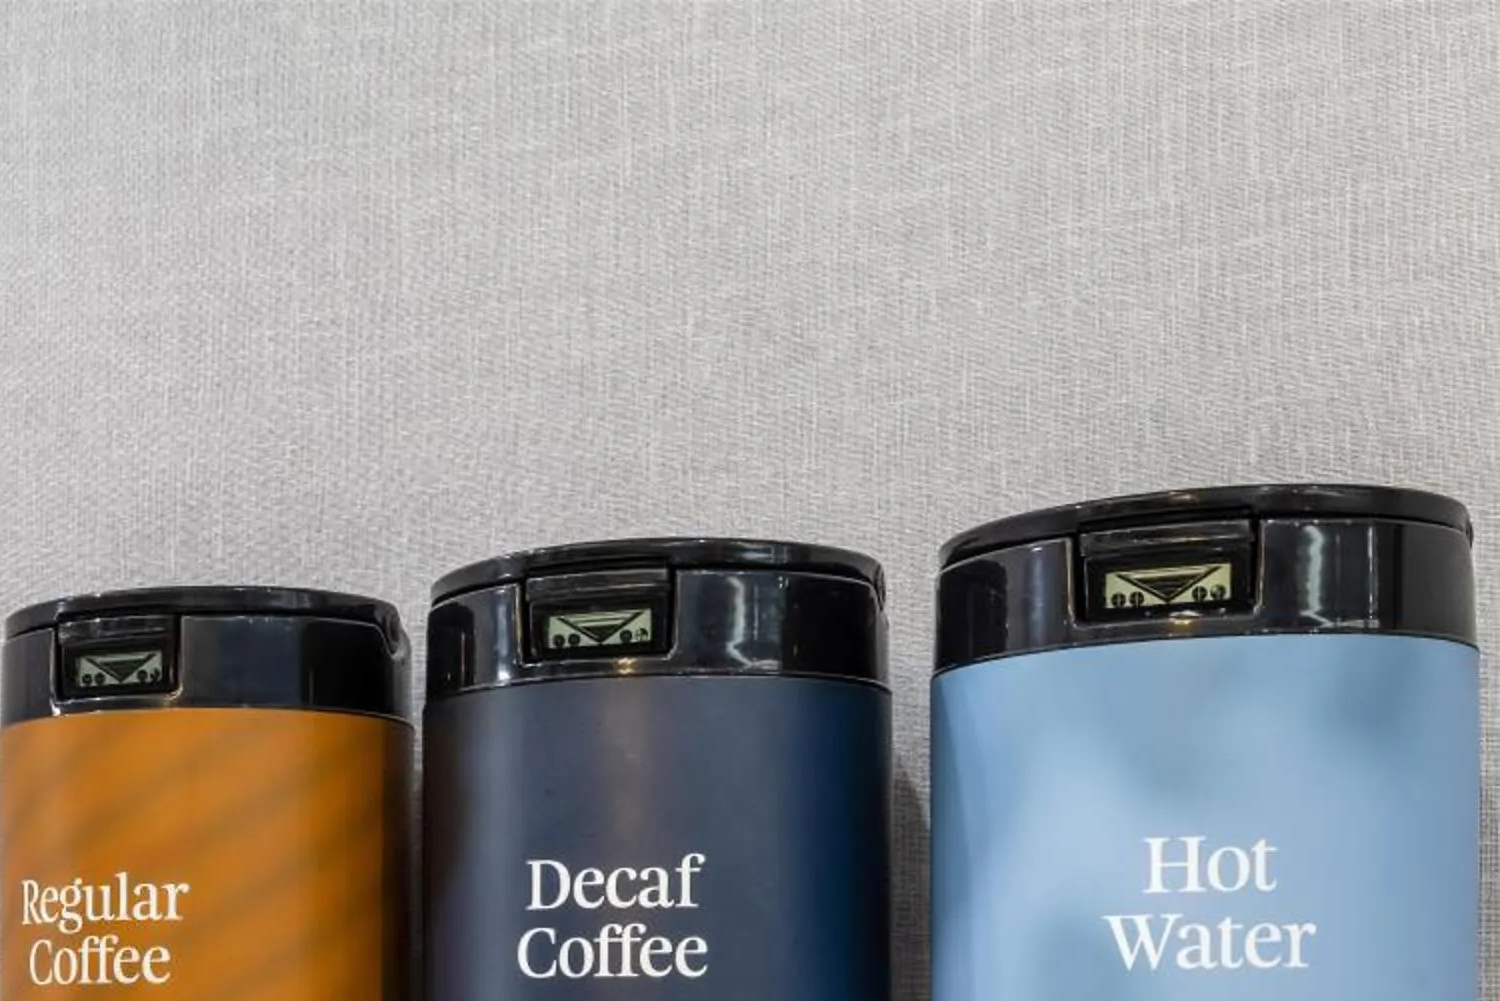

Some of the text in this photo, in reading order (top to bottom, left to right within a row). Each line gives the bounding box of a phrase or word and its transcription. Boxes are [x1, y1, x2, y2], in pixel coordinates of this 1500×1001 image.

[526, 852, 707, 912] Decaf
[1143, 835, 1278, 895] Hot
[21, 872, 191, 934] Regular
[29, 935, 172, 986] Coffee
[517, 922, 709, 980] Coffee
[1104, 912, 1317, 971] Water
